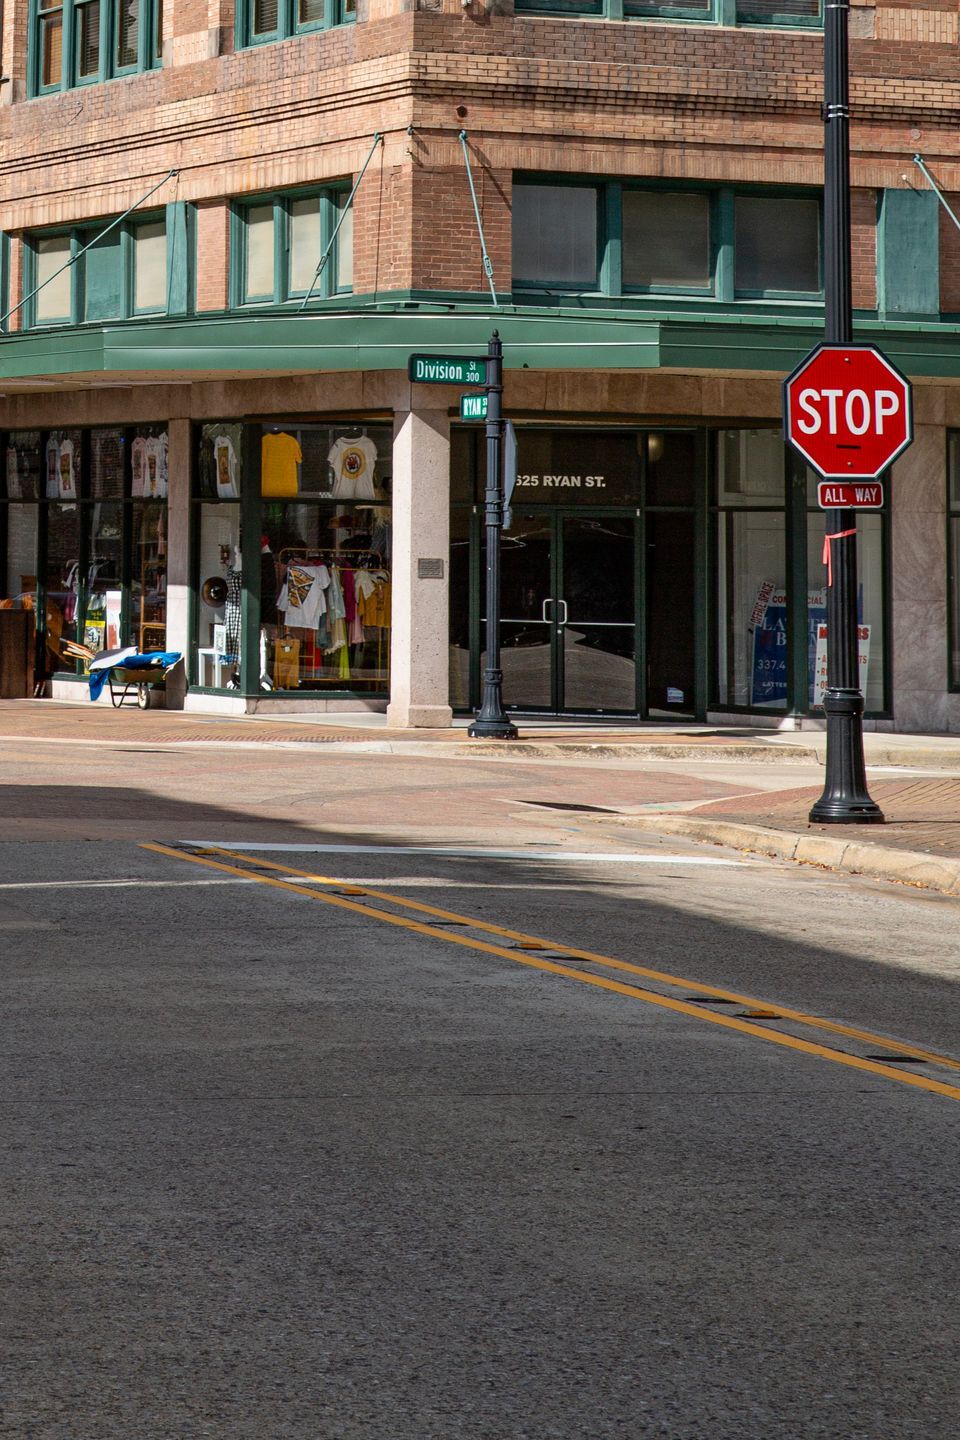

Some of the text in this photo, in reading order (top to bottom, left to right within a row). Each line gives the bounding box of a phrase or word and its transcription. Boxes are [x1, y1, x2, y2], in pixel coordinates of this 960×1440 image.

[416, 360, 463, 379] Division
[469, 361, 476, 371] St
[466, 372, 480, 382] 300
[463, 398, 481, 416] RYAN
[797, 388, 900, 436] STOP
[543, 475, 581, 487] RYAN
[584, 476, 606, 488] ST.
[825, 488, 878, 503] ALL WAY
[772, 595, 823, 605] COMCIAL
